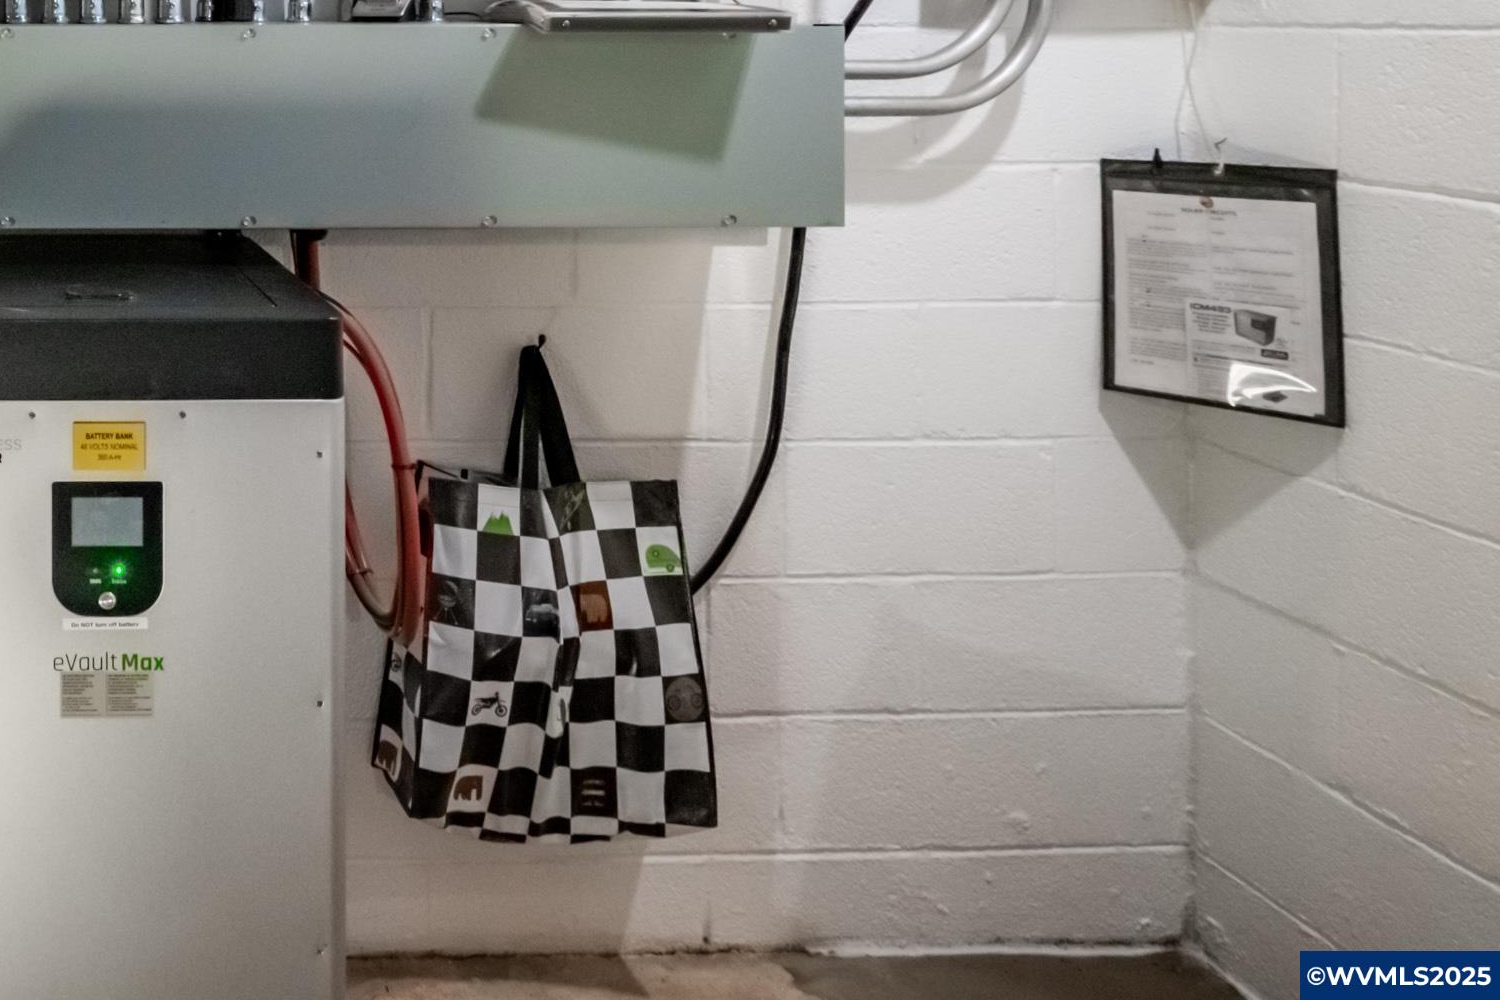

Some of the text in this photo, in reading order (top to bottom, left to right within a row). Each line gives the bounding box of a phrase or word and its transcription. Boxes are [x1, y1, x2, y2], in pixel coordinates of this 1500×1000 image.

[85, 432, 134, 440] BATTERY BANK
[53, 651, 164, 671] eVault Max
